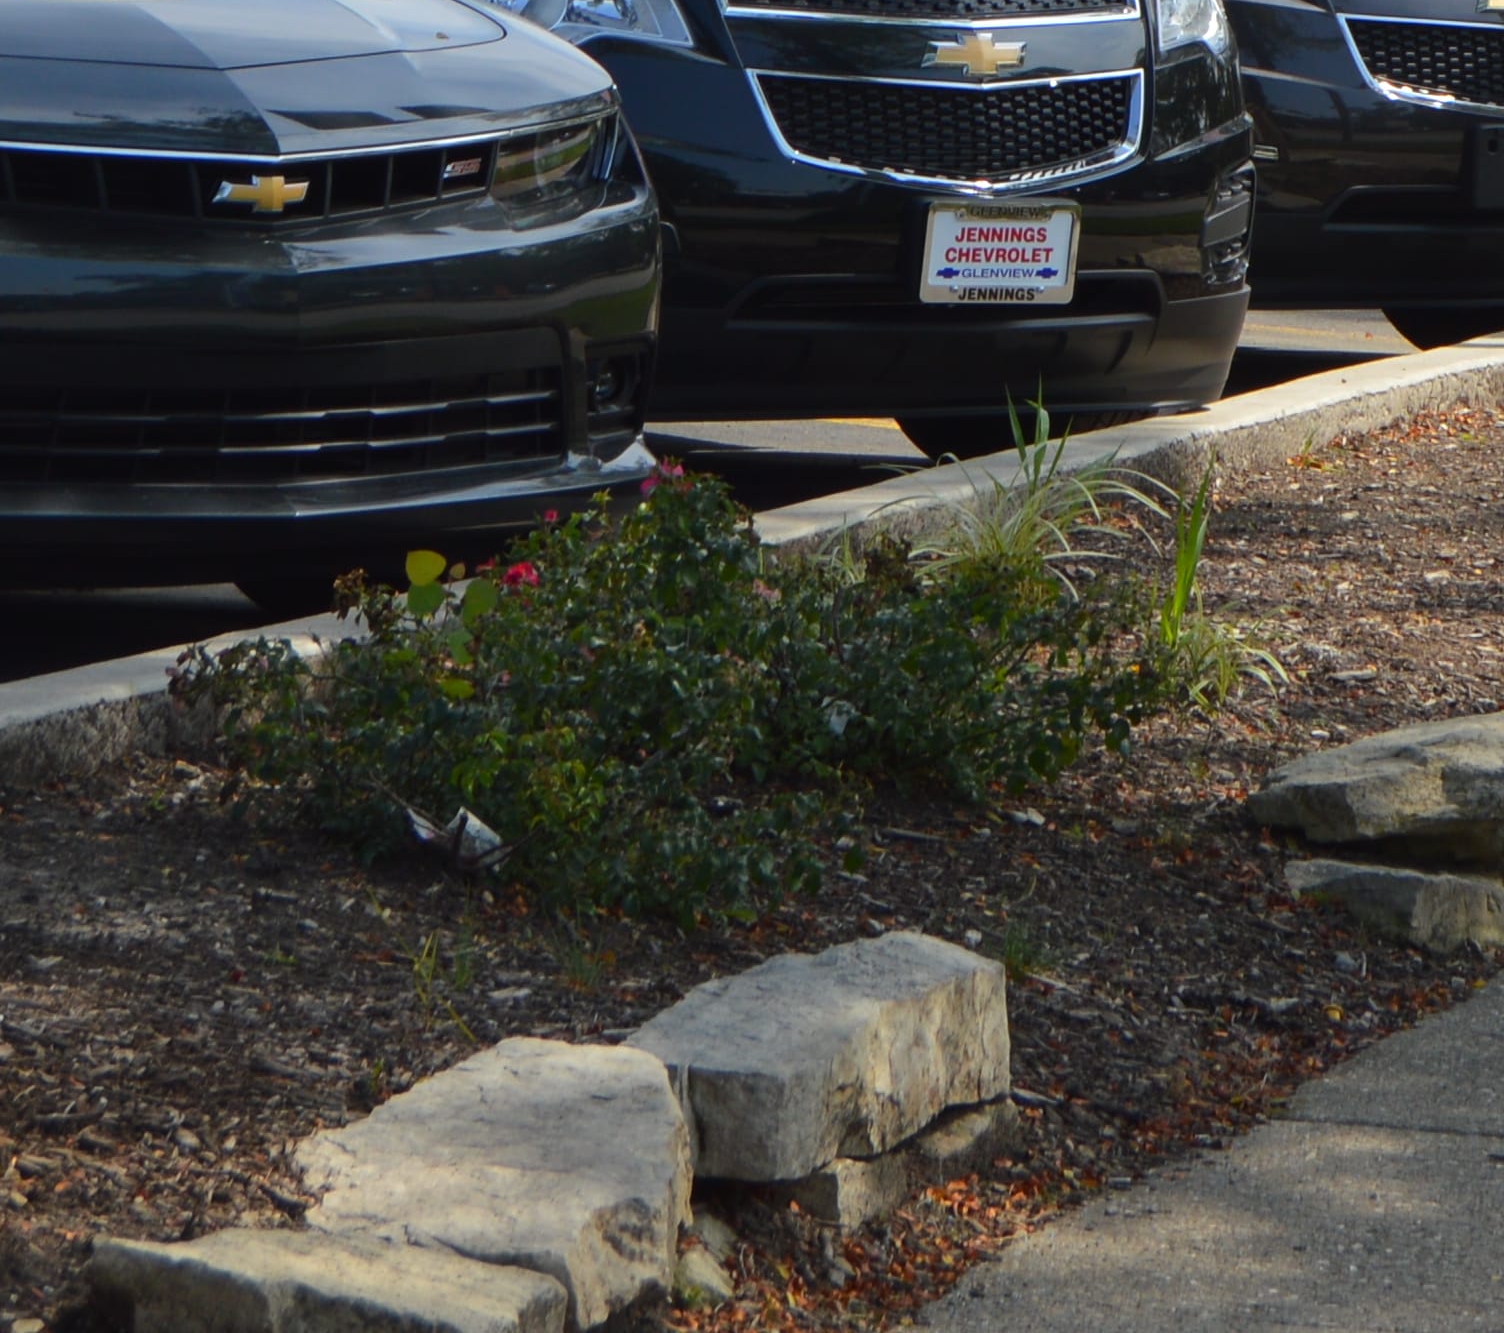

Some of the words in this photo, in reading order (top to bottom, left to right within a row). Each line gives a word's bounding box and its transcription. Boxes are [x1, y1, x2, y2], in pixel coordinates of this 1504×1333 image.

[955, 227, 1047, 243] JENNINGS
[945, 247, 1054, 263] CHEVROLET
[961, 268, 1035, 279] GLENVIEW
[958, 287, 1035, 302] JENNINGS
